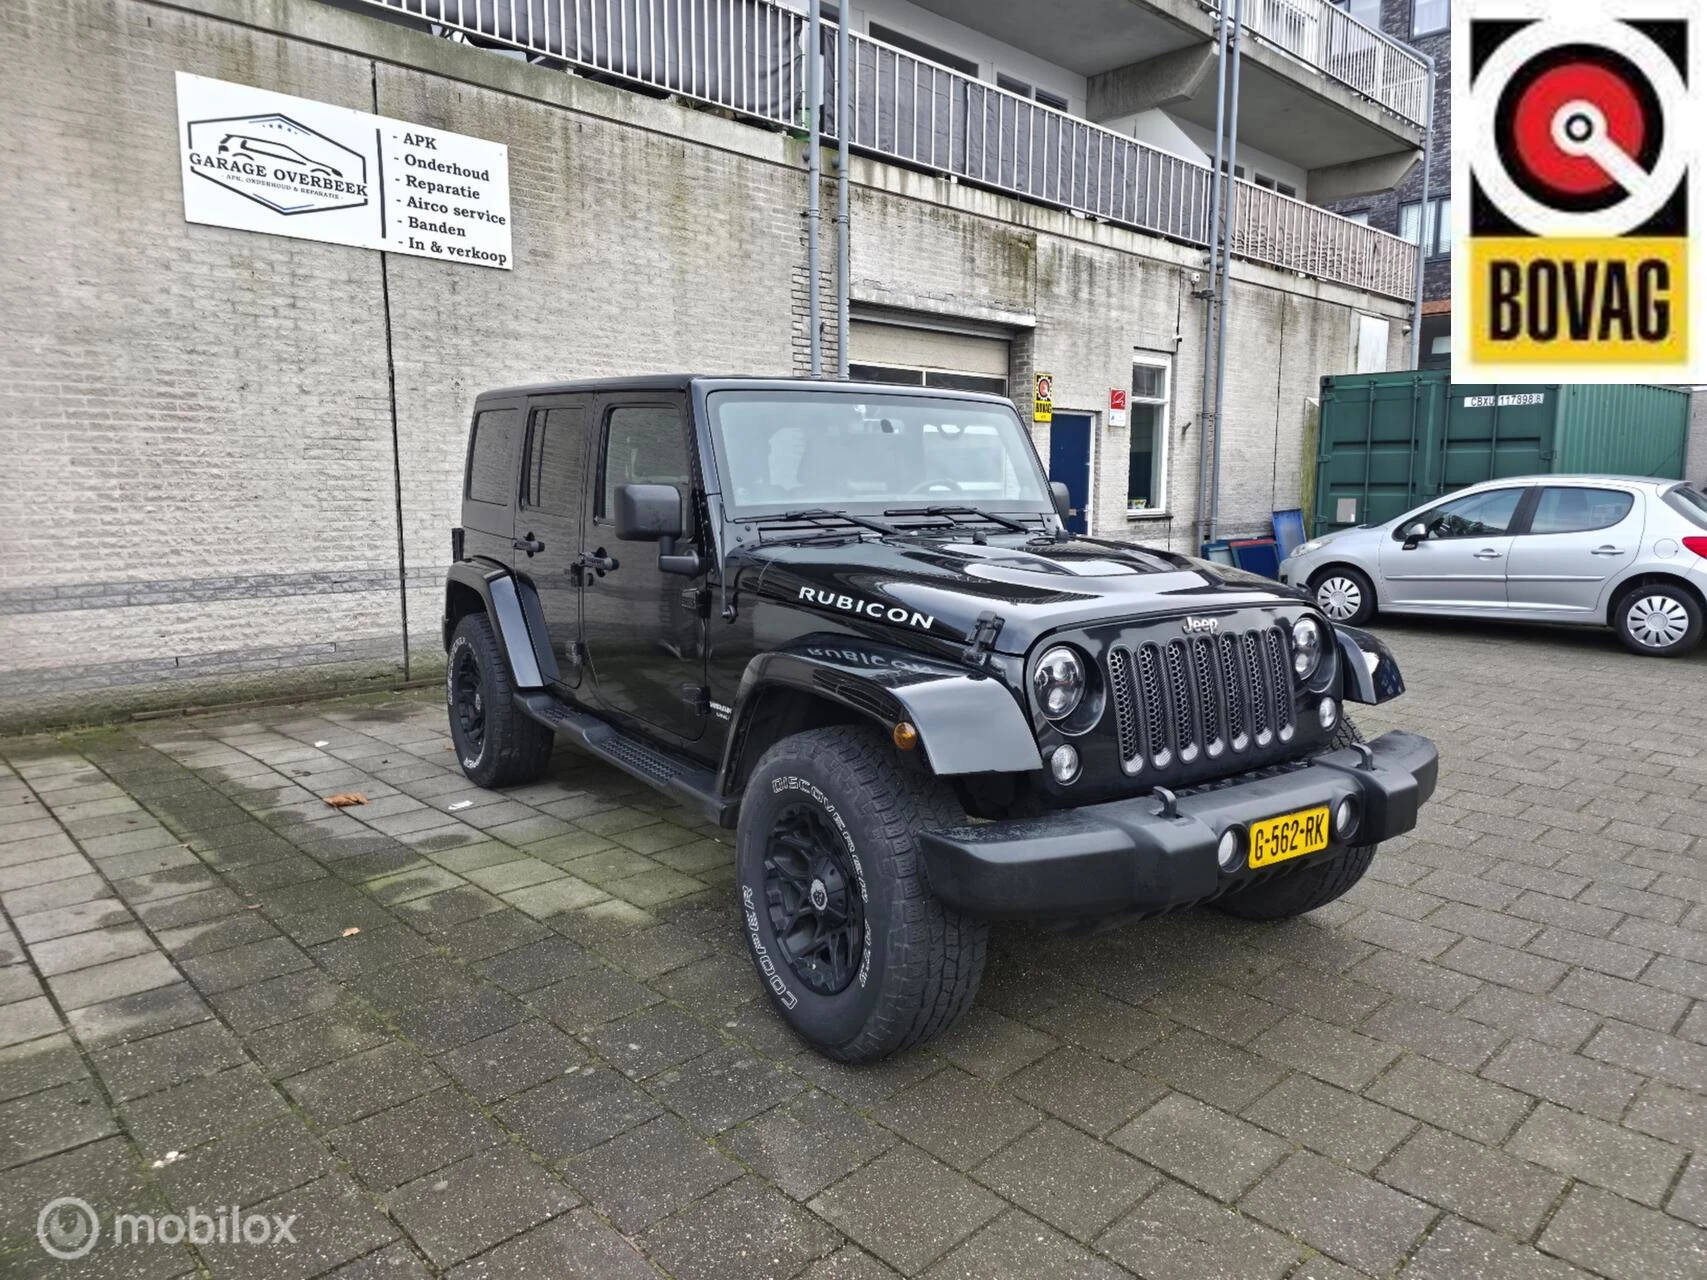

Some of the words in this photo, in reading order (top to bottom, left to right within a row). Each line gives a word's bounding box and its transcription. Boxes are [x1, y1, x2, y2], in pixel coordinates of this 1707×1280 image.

[403, 132, 438, 150] APK
[189, 152, 267, 177] GARAGE
[273, 168, 368, 197] OVERBEEK
[404, 153, 490, 182] Onderhoud
[405, 174, 480, 199] Reparatie
[407, 195, 448, 214] Airco
[453, 206, 506, 225] service
[408, 215, 466, 237] Banden
[408, 237, 425, 251] In
[430, 241, 443, 254] &
[447, 246, 507, 266] verkoop
[798, 586, 934, 630] RUBICON
[1182, 616, 1218, 635] Jeep
[1255, 813, 1325, 861] G-562-RK
[742, 885, 798, 1010] COOPER
